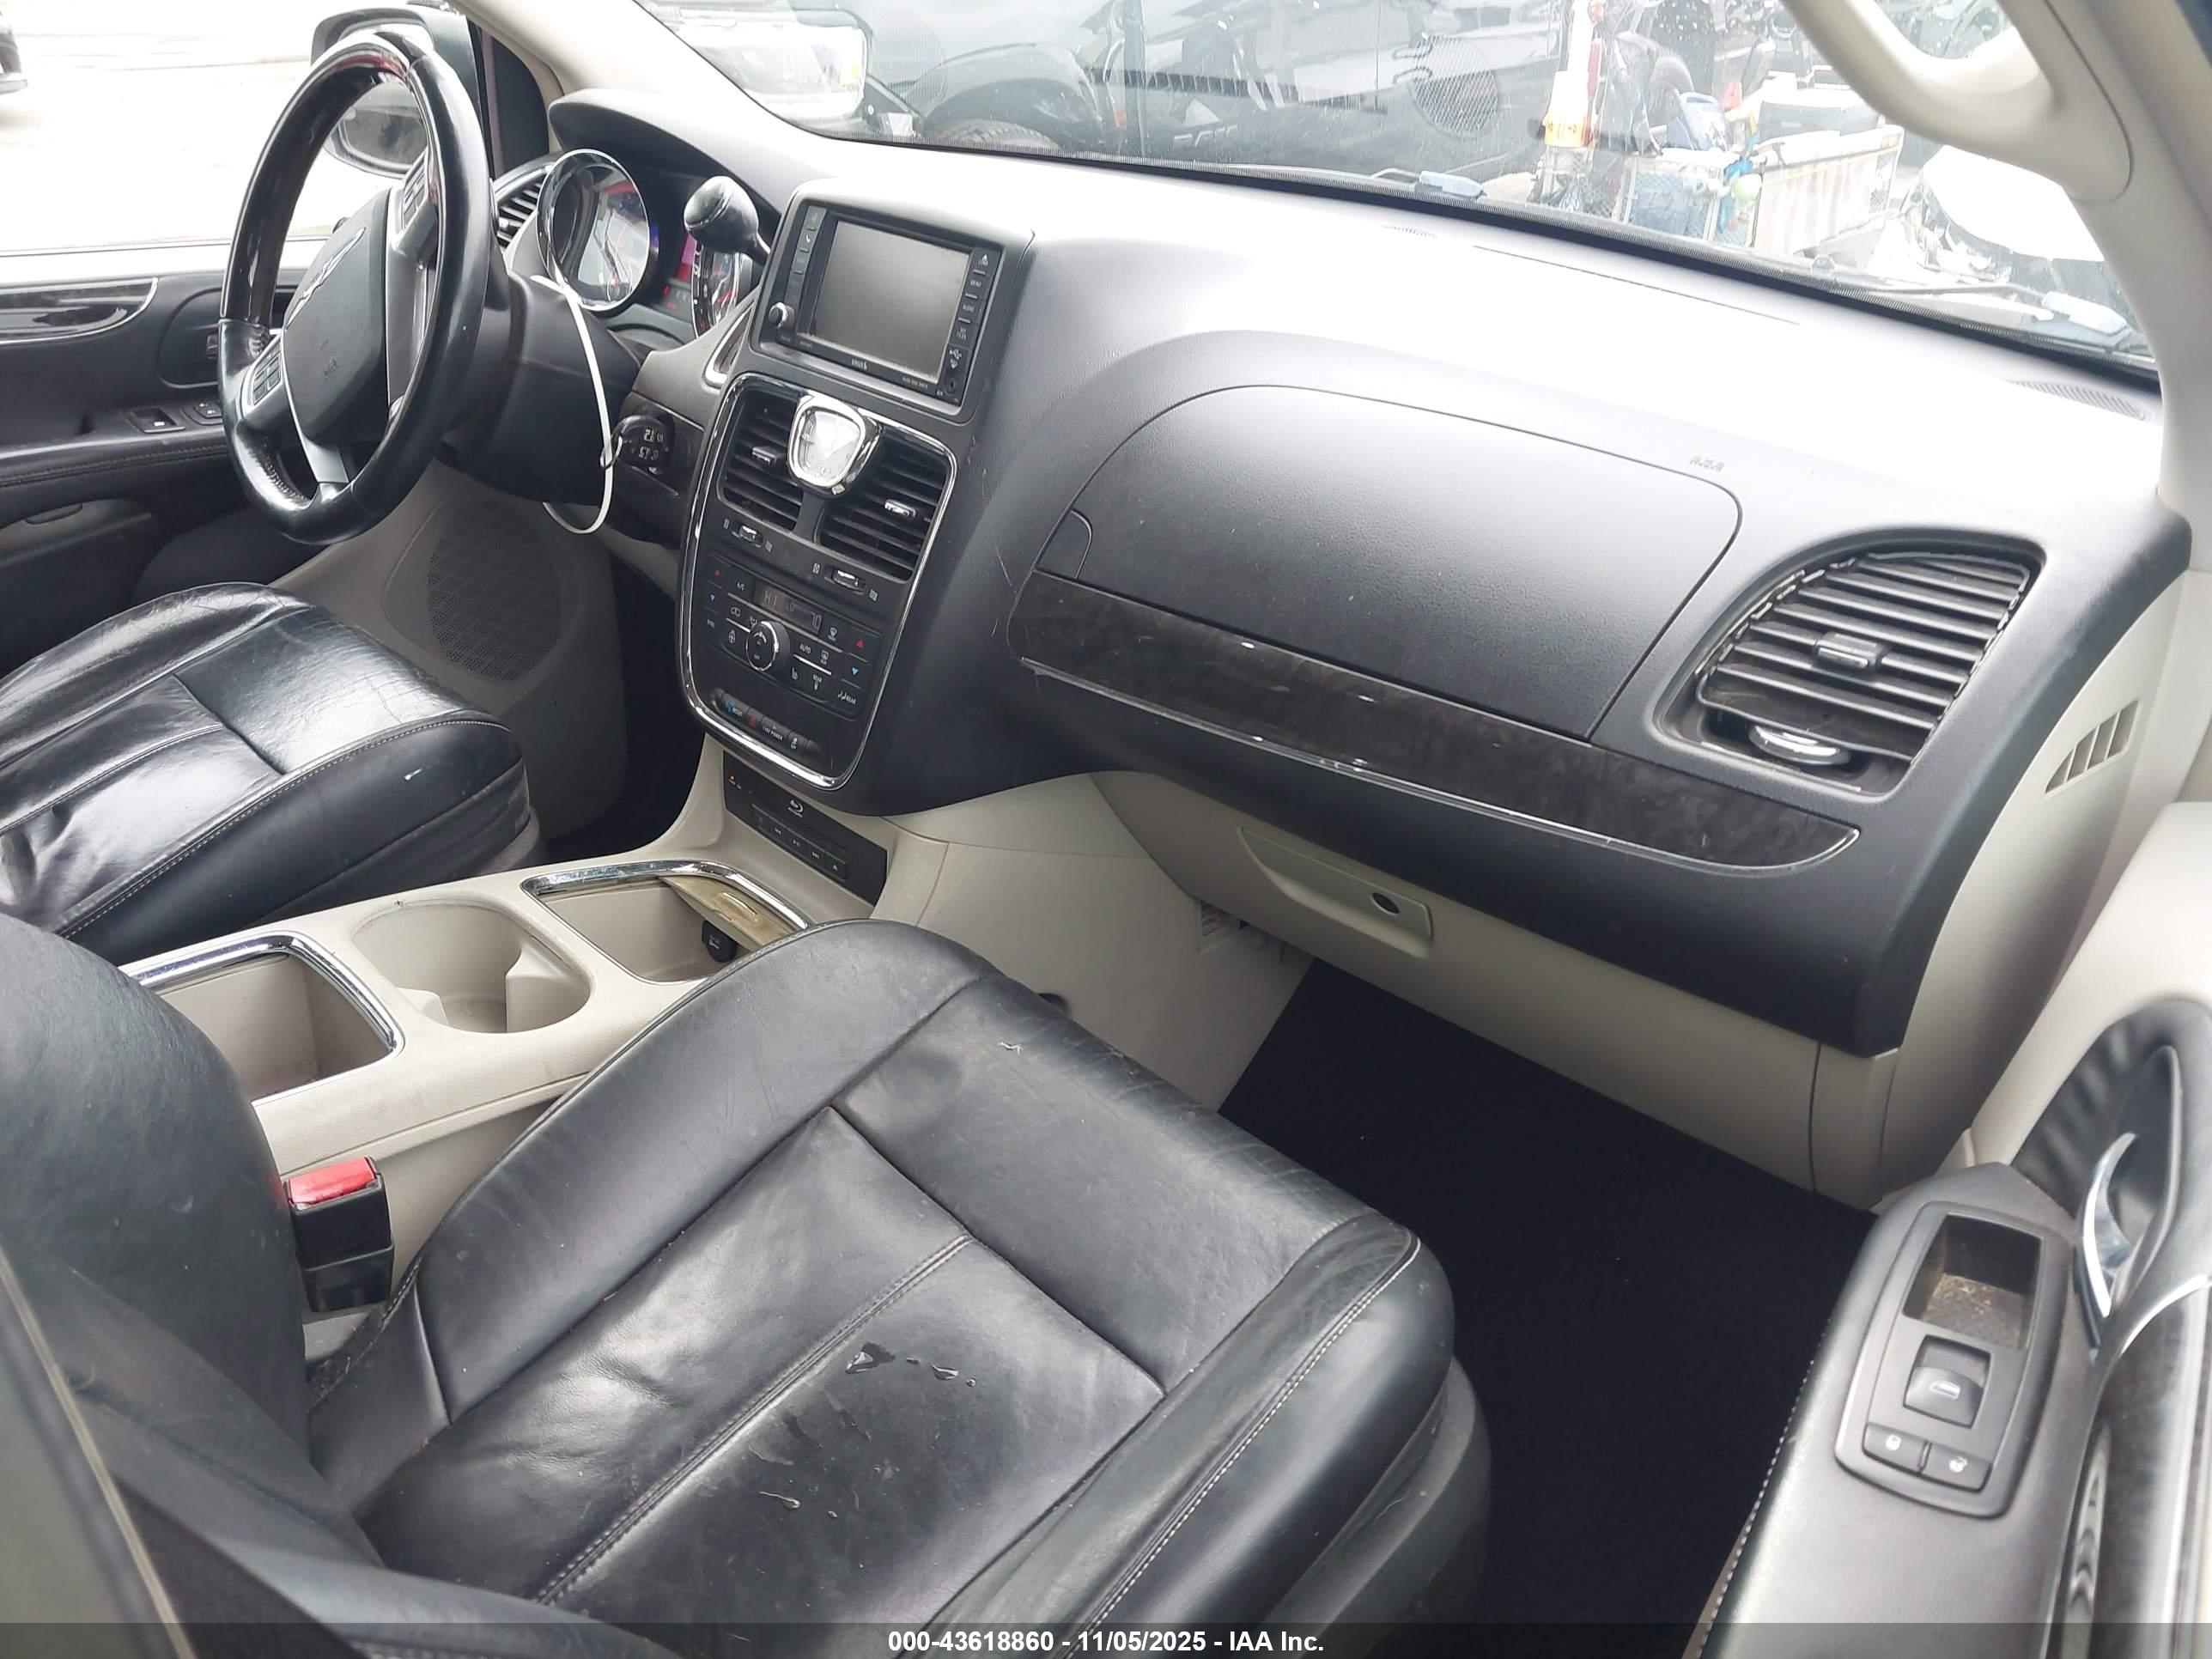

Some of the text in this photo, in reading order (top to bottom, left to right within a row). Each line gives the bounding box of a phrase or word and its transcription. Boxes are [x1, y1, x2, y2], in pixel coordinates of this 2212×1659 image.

[969, 279, 982, 288] MENU
[962, 303, 975, 312] AUDIO
[799, 643, 811, 654] AUTO
[812, 674, 823, 683] REAR
[846, 695, 857, 705] REAR
